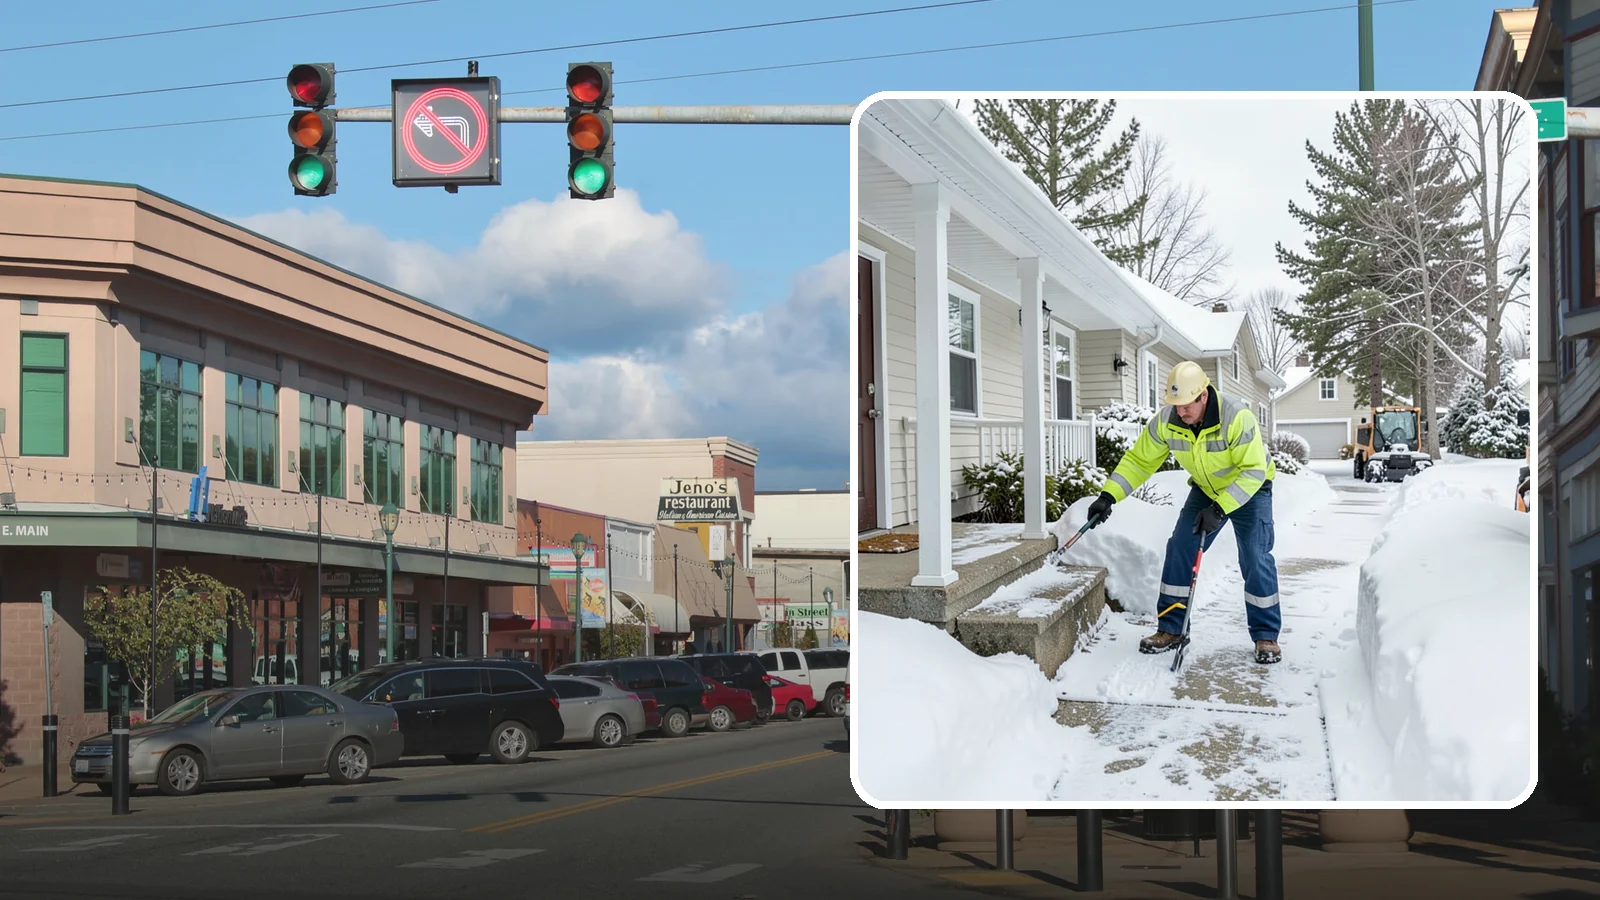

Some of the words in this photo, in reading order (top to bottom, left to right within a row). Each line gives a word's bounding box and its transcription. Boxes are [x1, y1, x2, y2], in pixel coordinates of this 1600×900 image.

[670, 480, 728, 494] Jeno's
[665, 496, 731, 509] restaurant
[686, 510, 714, 519] American
[715, 510, 737, 519] Cuisine
[2, 525, 13, 536] E.
[15, 525, 49, 536] MAIN
[797, 608, 828, 617] Street
